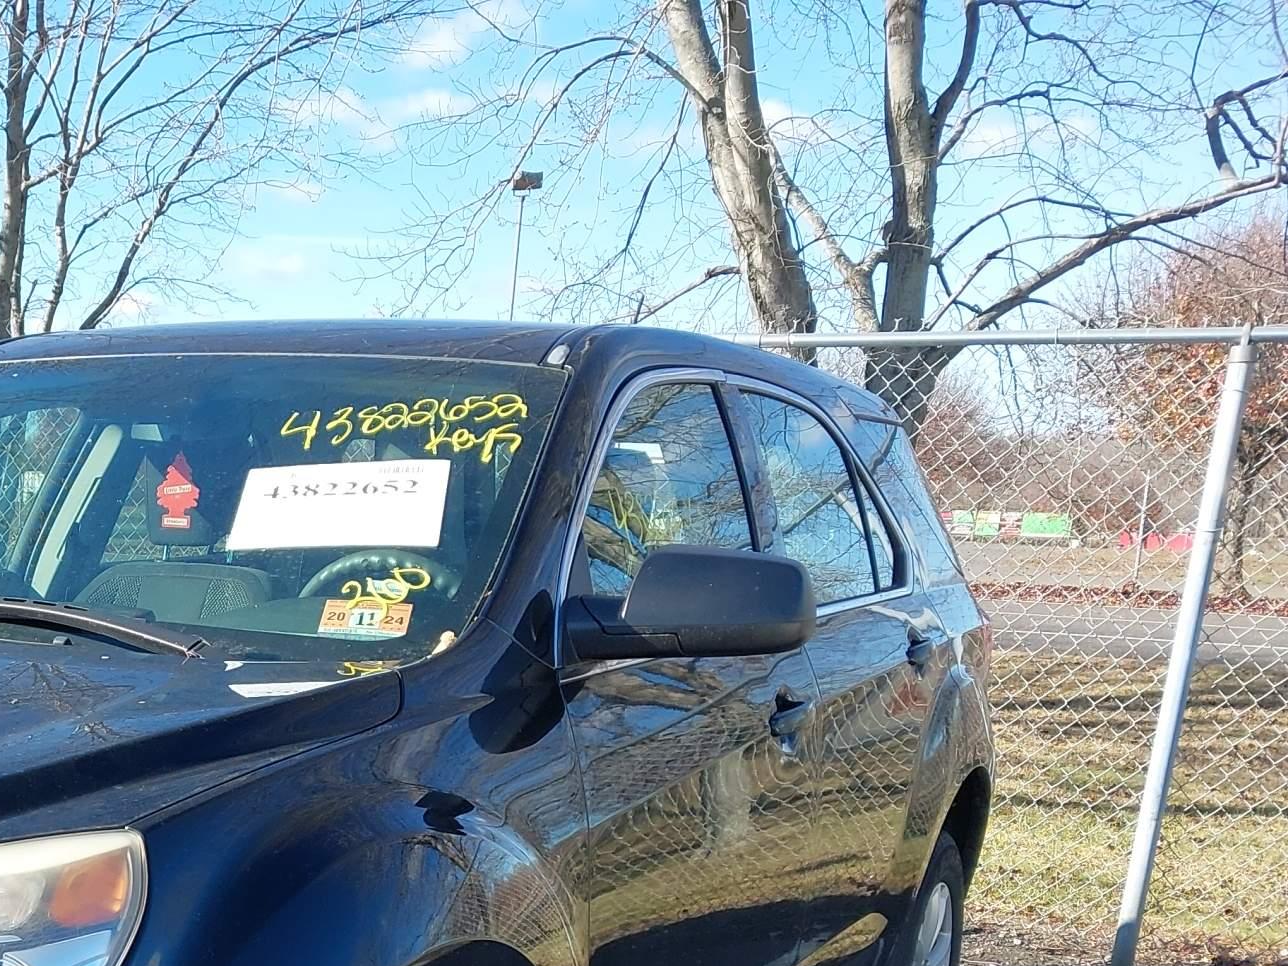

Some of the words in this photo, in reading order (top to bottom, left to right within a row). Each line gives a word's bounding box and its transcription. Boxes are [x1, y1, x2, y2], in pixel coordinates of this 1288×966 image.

[280, 393, 527, 450] 43822652
[263, 479, 419, 499] 43822652
[327, 611, 346, 621] 20
[355, 611, 376, 626] 11
[383, 615, 404, 625] 24
